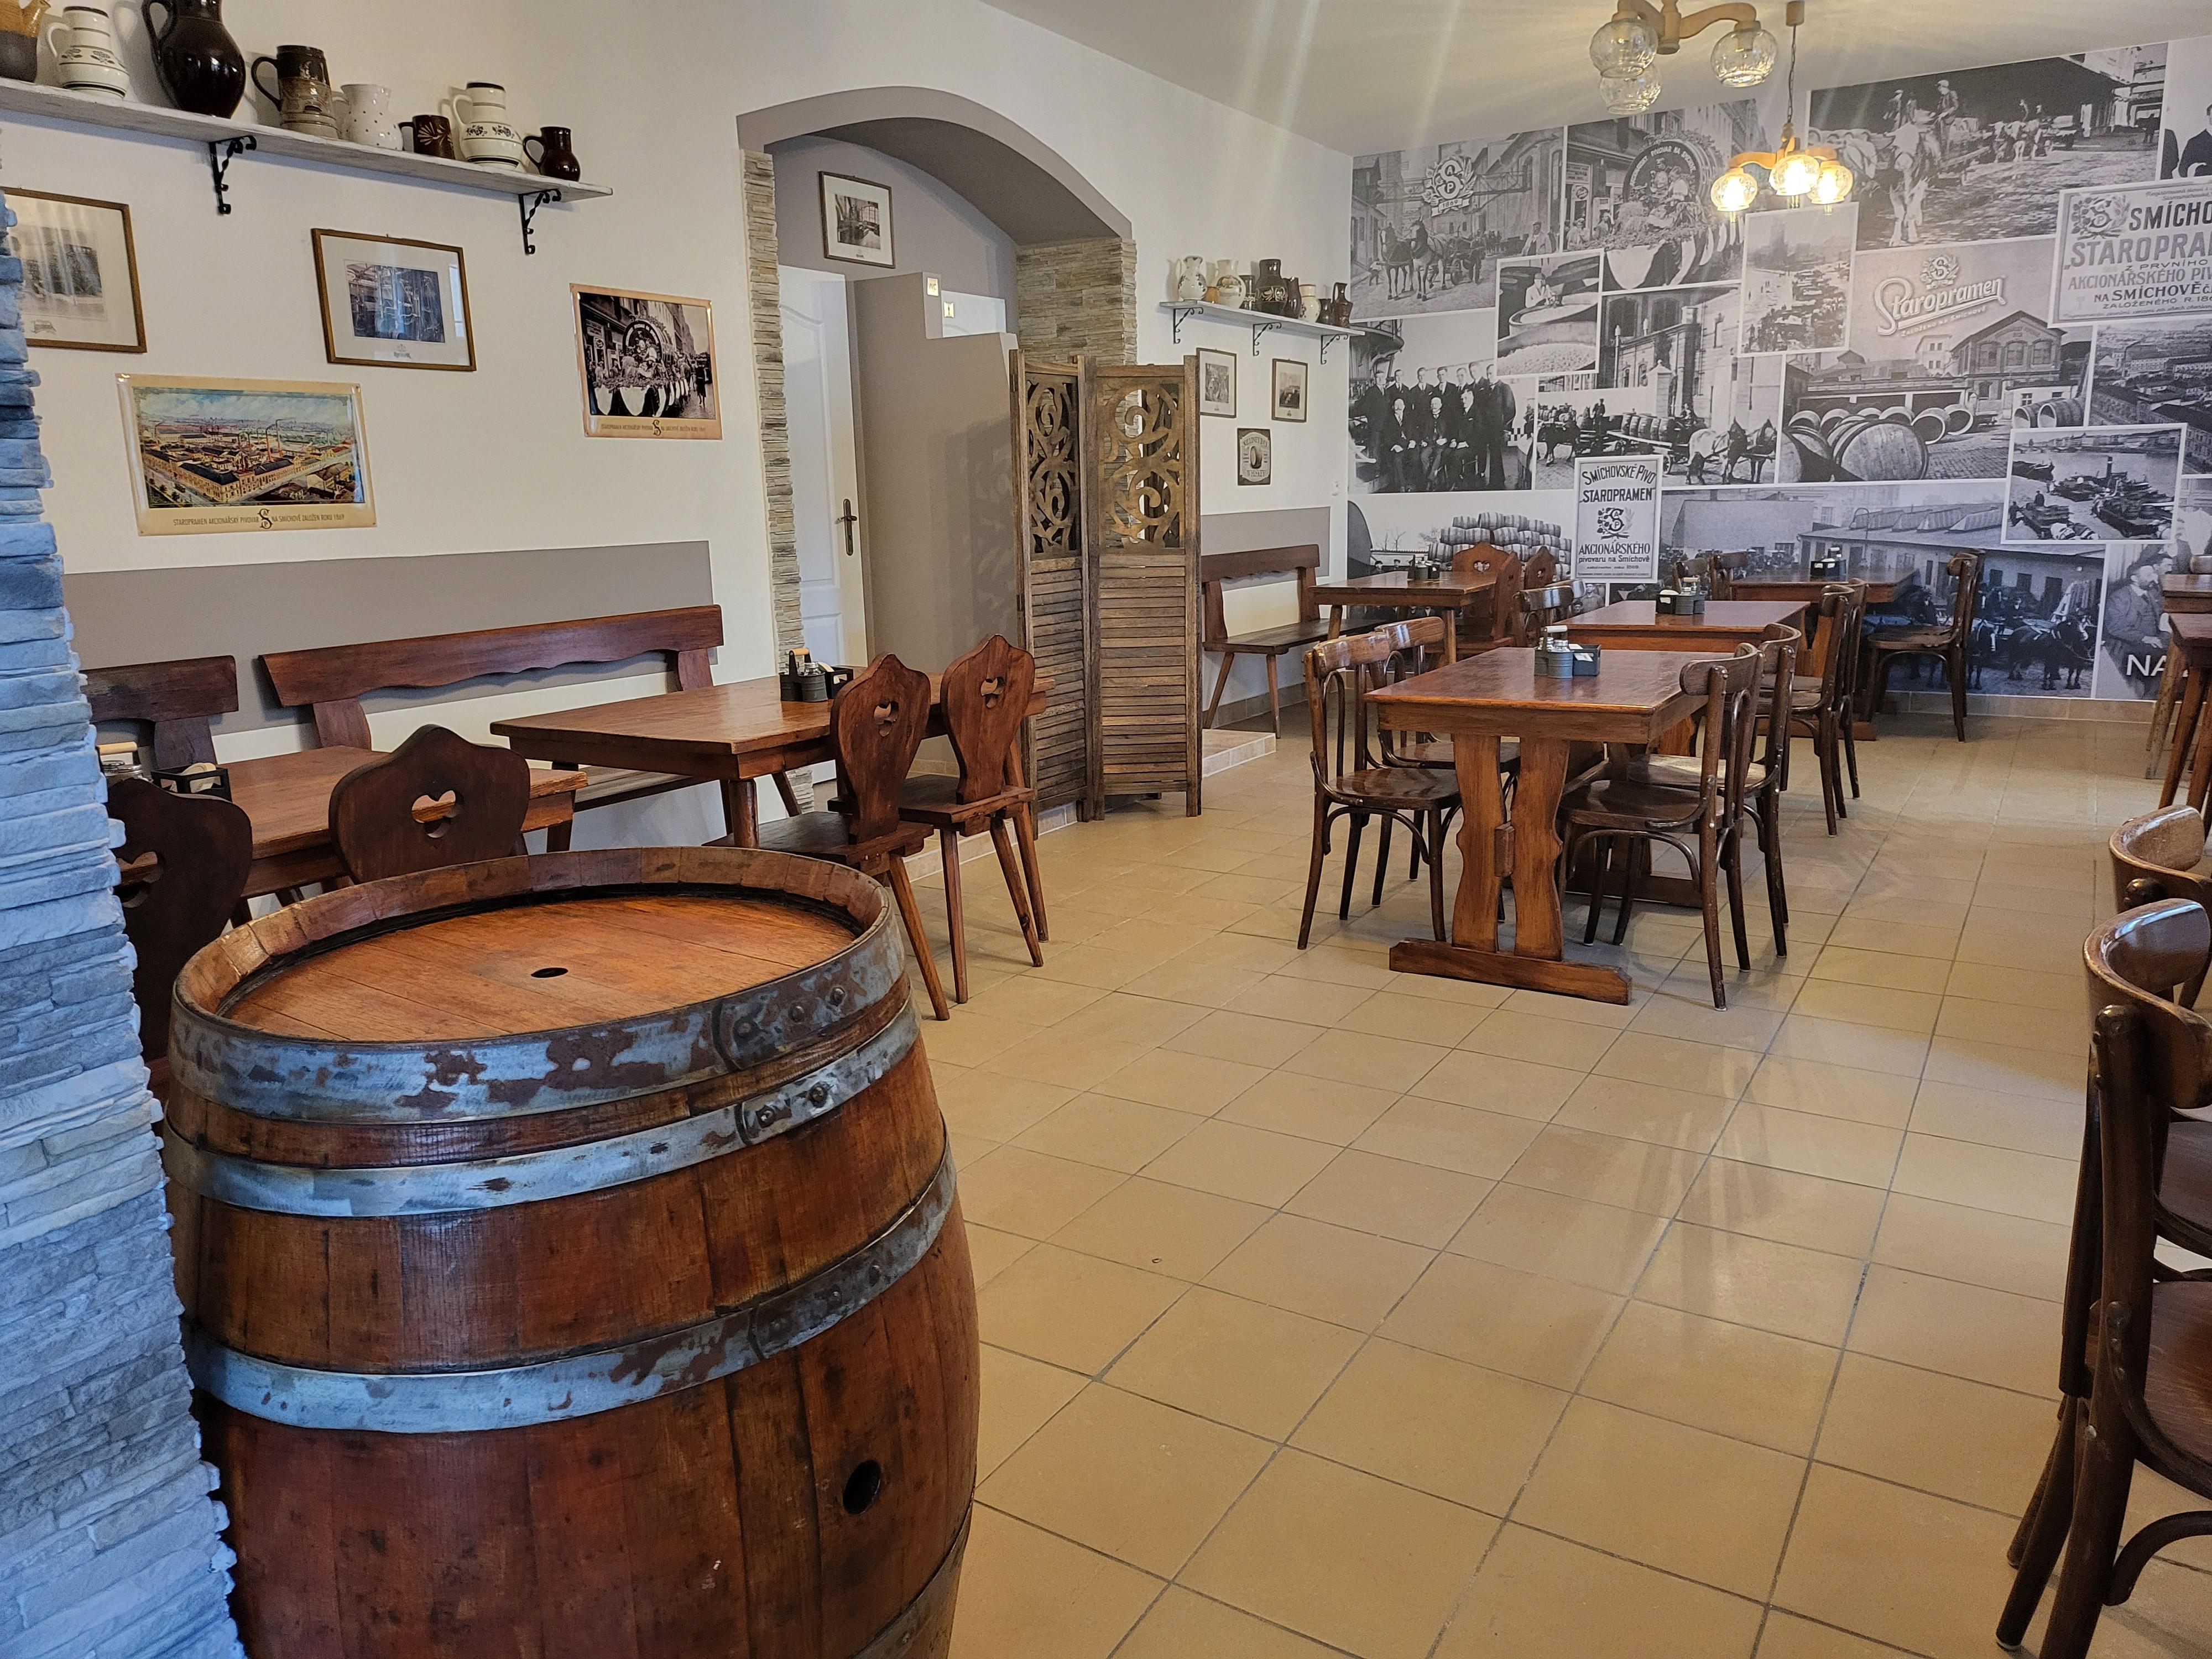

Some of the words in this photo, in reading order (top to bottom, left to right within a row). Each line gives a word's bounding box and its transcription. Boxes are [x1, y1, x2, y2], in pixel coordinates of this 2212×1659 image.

[1442, 200, 1458, 208] 1869
[2140, 259, 2208, 270] PRVNÍHO
[2068, 268, 2185, 290] AKCIONÁŘSKÉHO
[2094, 294, 2109, 302] NA
[2112, 281, 2201, 301] SMÍCHOVĚ
[1875, 278, 2006, 336] Staropramen
[2103, 297, 2177, 309] ZALOŽENÉHO
[1635, 465, 1656, 484] PIVO
[1579, 540, 1651, 555] AKCIONÁŘSKÉHO
